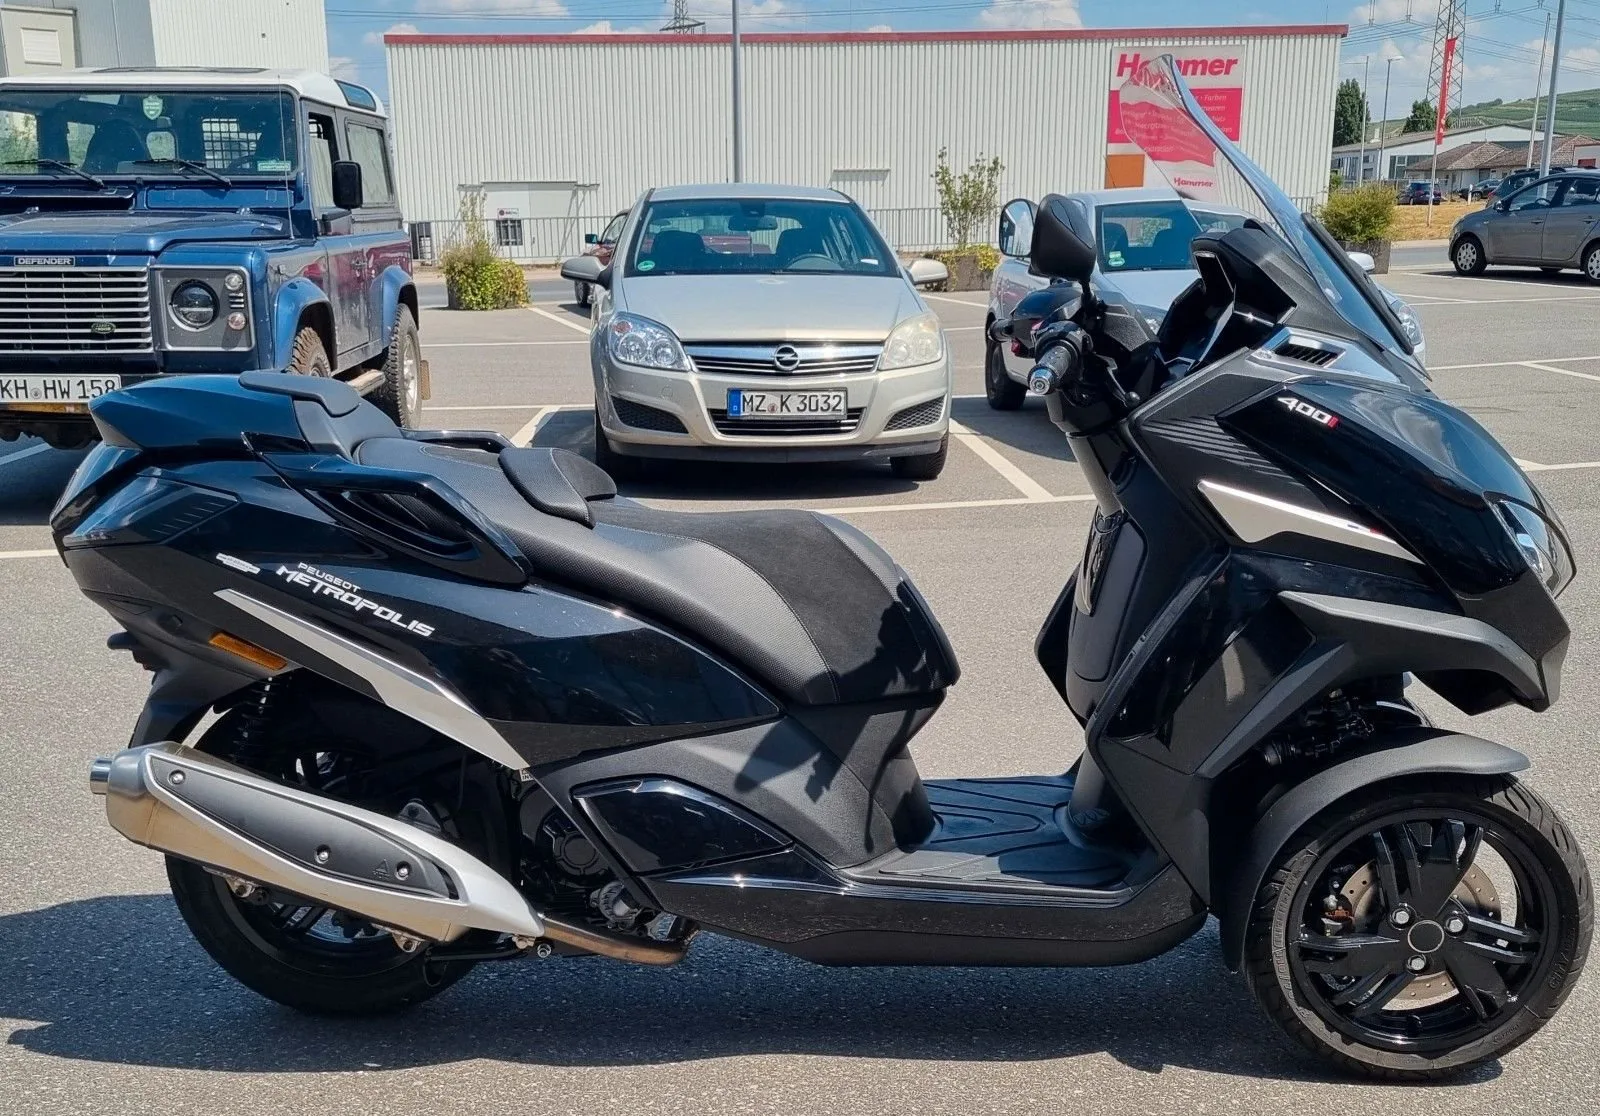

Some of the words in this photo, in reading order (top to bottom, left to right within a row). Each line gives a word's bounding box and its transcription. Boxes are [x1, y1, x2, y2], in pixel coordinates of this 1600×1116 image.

[1116, 53, 1238, 78] Hmer
[0, 379, 28, 399] KH
[43, 379, 71, 399] HW
[742, 394, 767, 413] MZ
[780, 394, 791, 413] K
[796, 394, 842, 413] 3032
[297, 561, 362, 593] PEUGEOT
[275, 564, 436, 638] METROPOLIS
